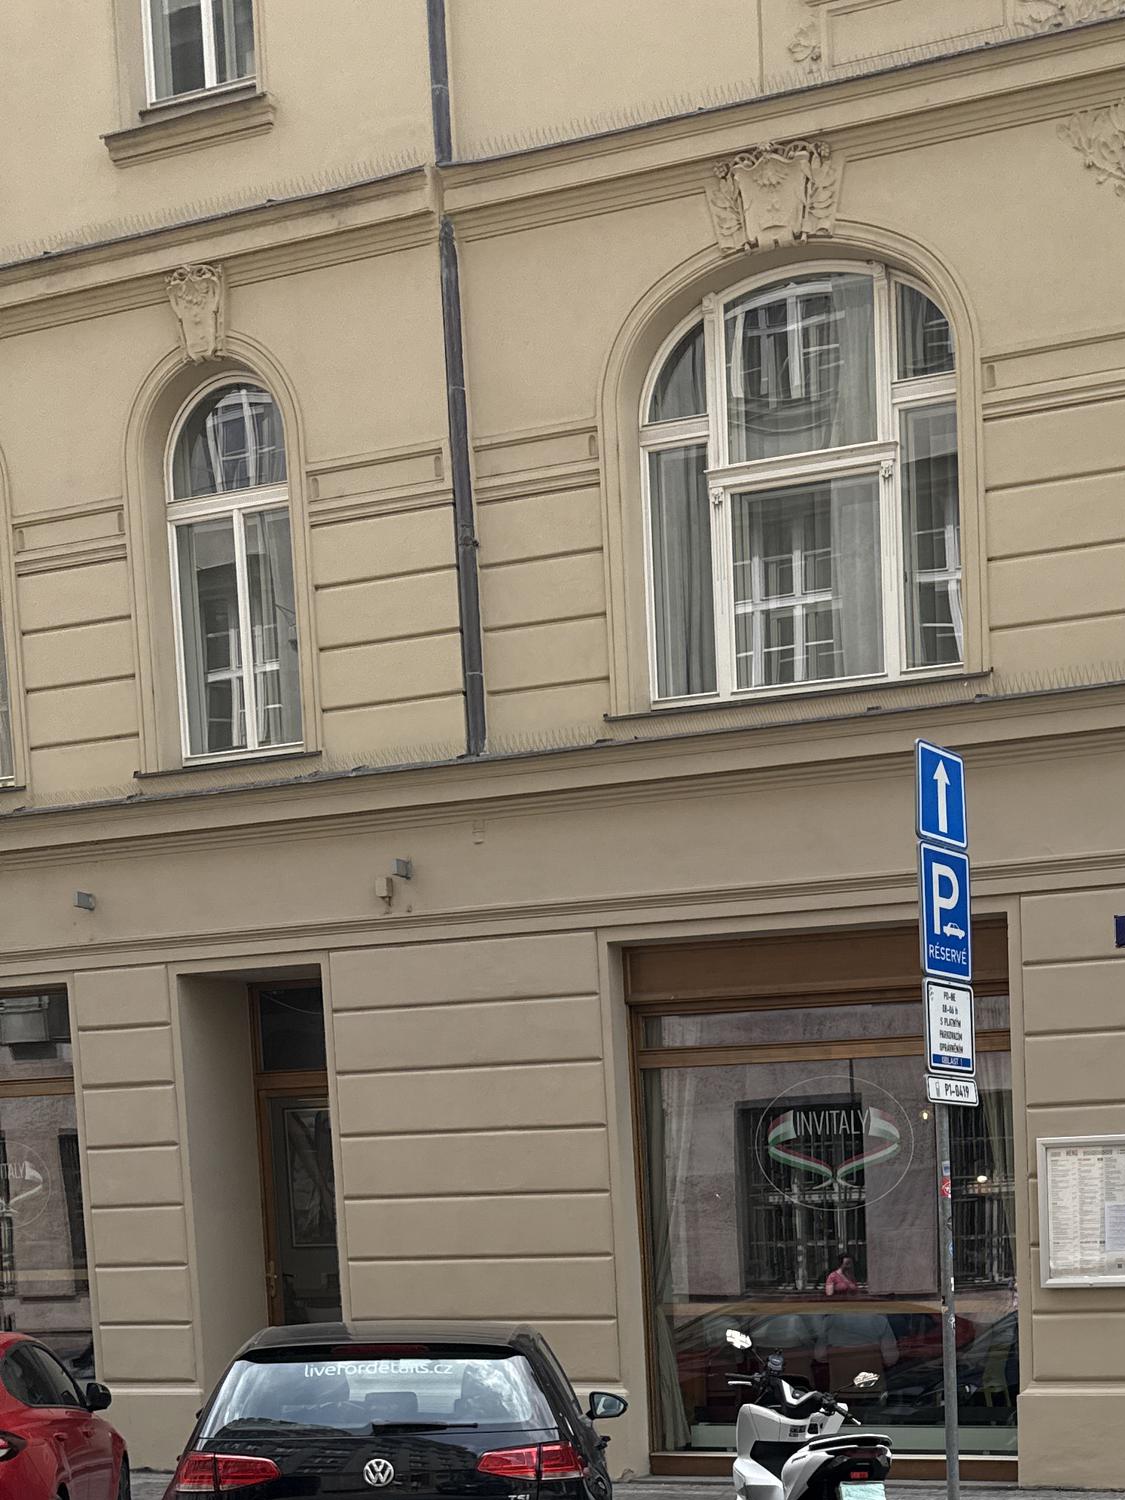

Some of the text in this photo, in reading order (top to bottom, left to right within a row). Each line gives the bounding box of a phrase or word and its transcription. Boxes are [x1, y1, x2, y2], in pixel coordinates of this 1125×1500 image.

[932, 861, 960, 935] P
[928, 942, 968, 965] RÉSERVÉ
[944, 1083, 970, 1098] P1-0419
[796, 1109, 869, 1136] INVITALY
